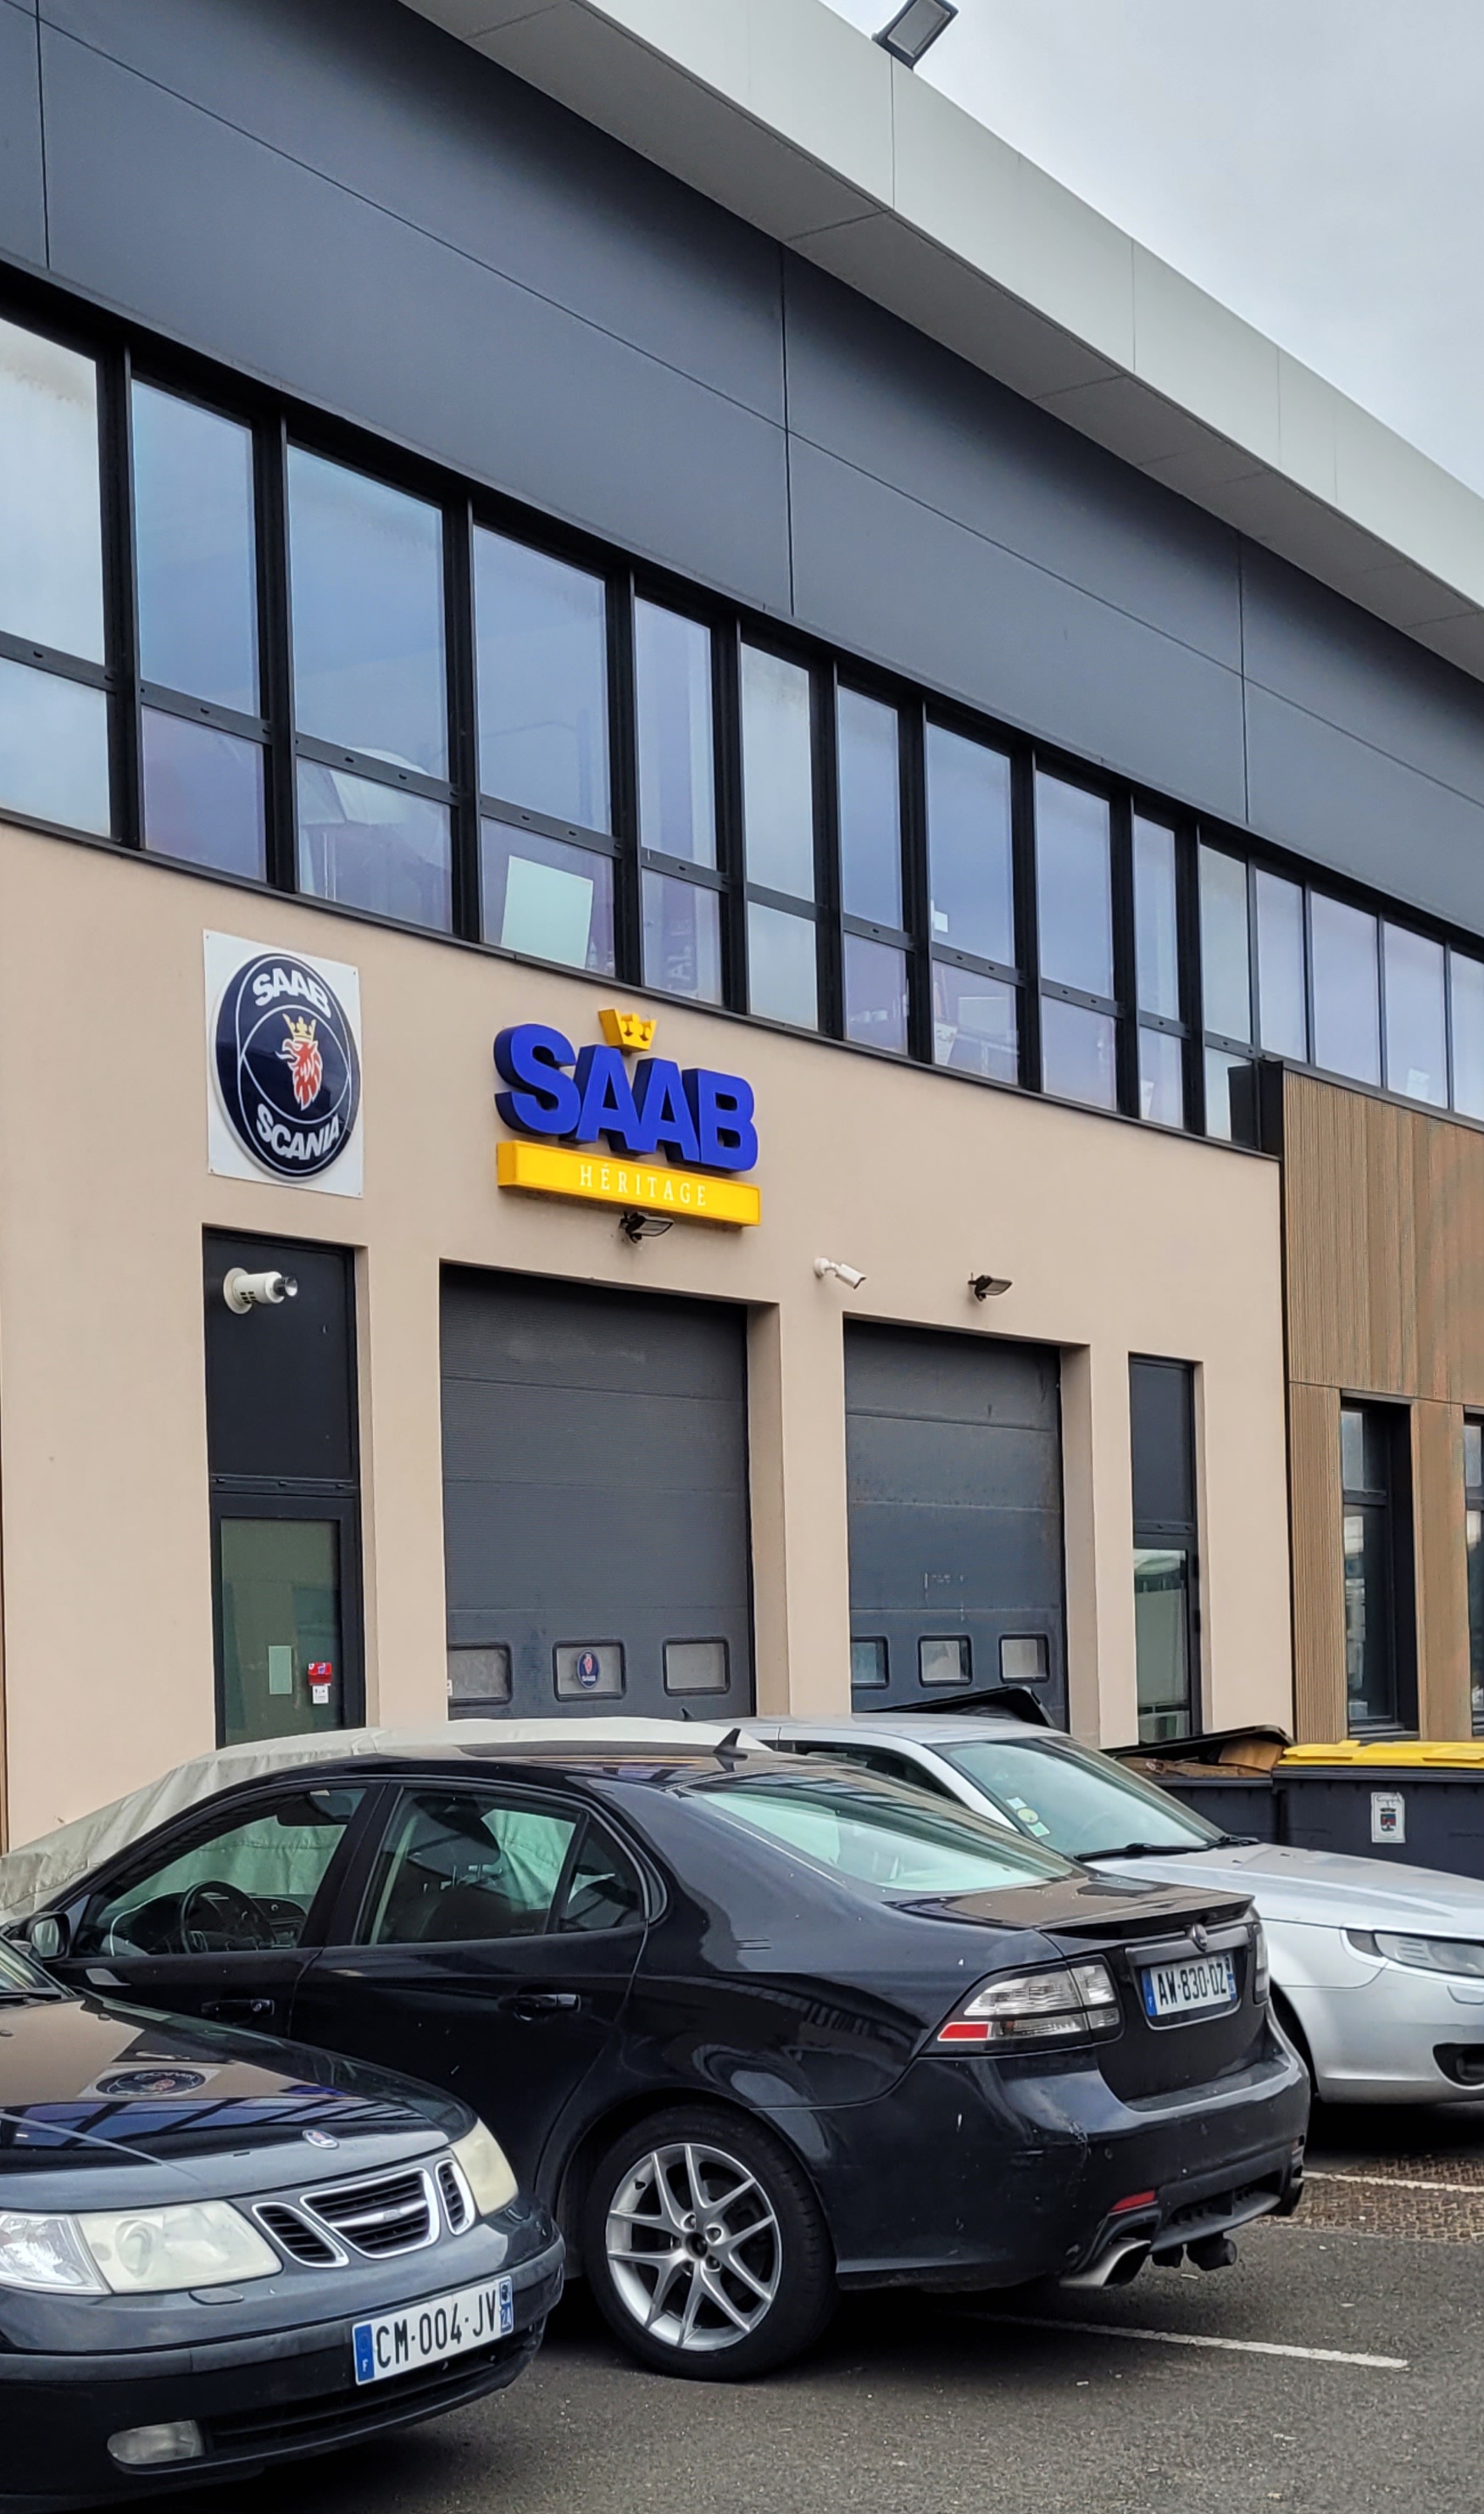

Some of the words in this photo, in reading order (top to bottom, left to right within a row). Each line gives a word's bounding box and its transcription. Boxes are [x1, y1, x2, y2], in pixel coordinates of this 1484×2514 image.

[253, 967, 331, 1019] SAAB
[492, 1022, 759, 1173] SAAB
[256, 1103, 340, 1160] SCANIA
[580, 1164, 707, 1207] HÉRITAGE
[1157, 1961, 1227, 2007] AW-830-DZ
[375, 2289, 497, 2369] CM-004-JV
